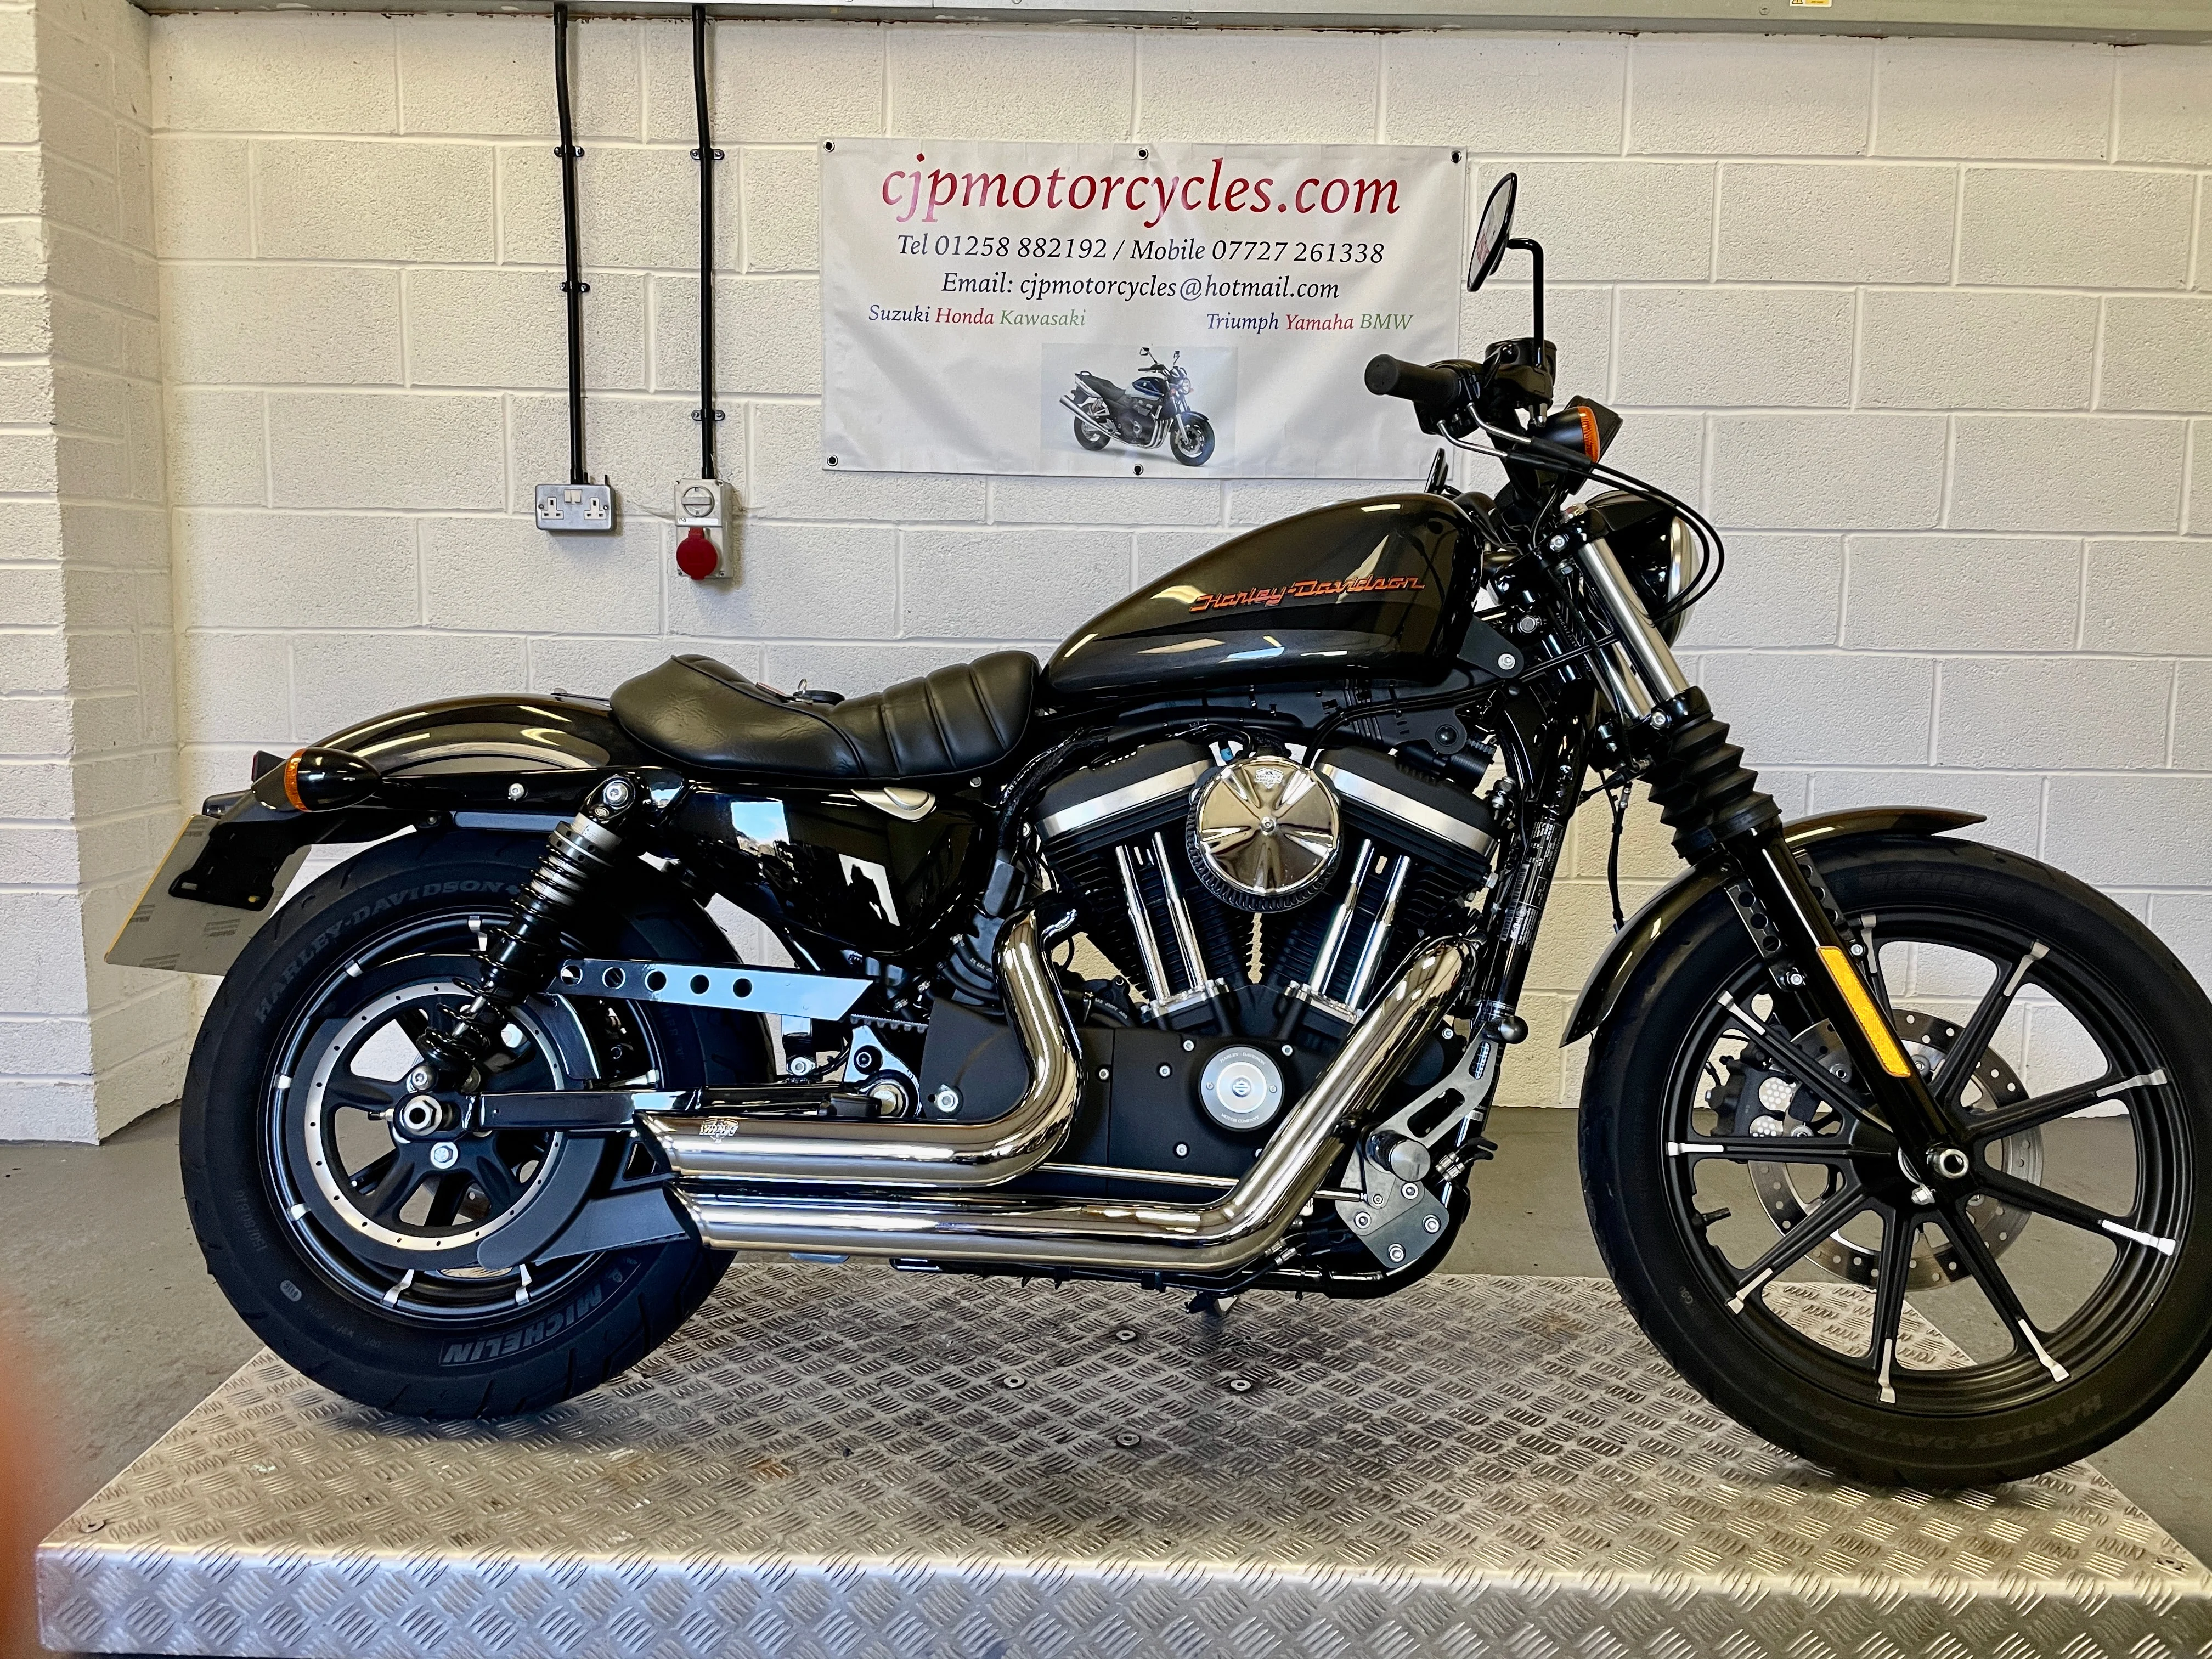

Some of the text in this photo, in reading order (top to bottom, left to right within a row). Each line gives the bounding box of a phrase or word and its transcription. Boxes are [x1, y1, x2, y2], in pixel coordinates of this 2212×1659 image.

[882, 153, 1400, 228] cjpmotorcycles.com
[898, 233, 1385, 264] Tel 01258 882192 / Mobile 07727 261338
[941, 272, 1340, 302] Email: cjpmotorcycles@hotmail.com
[868, 304, 1086, 326] Suzuki Honda Kawasaki
[1206, 312, 1414, 334] Triumph Yamaha BMW
[1189, 574, 1426, 613] Harley-Davidson
[1221, 1113, 1260, 1124] MOTOR COMPANY
[442, 1283, 603, 1364] MICHELIN
